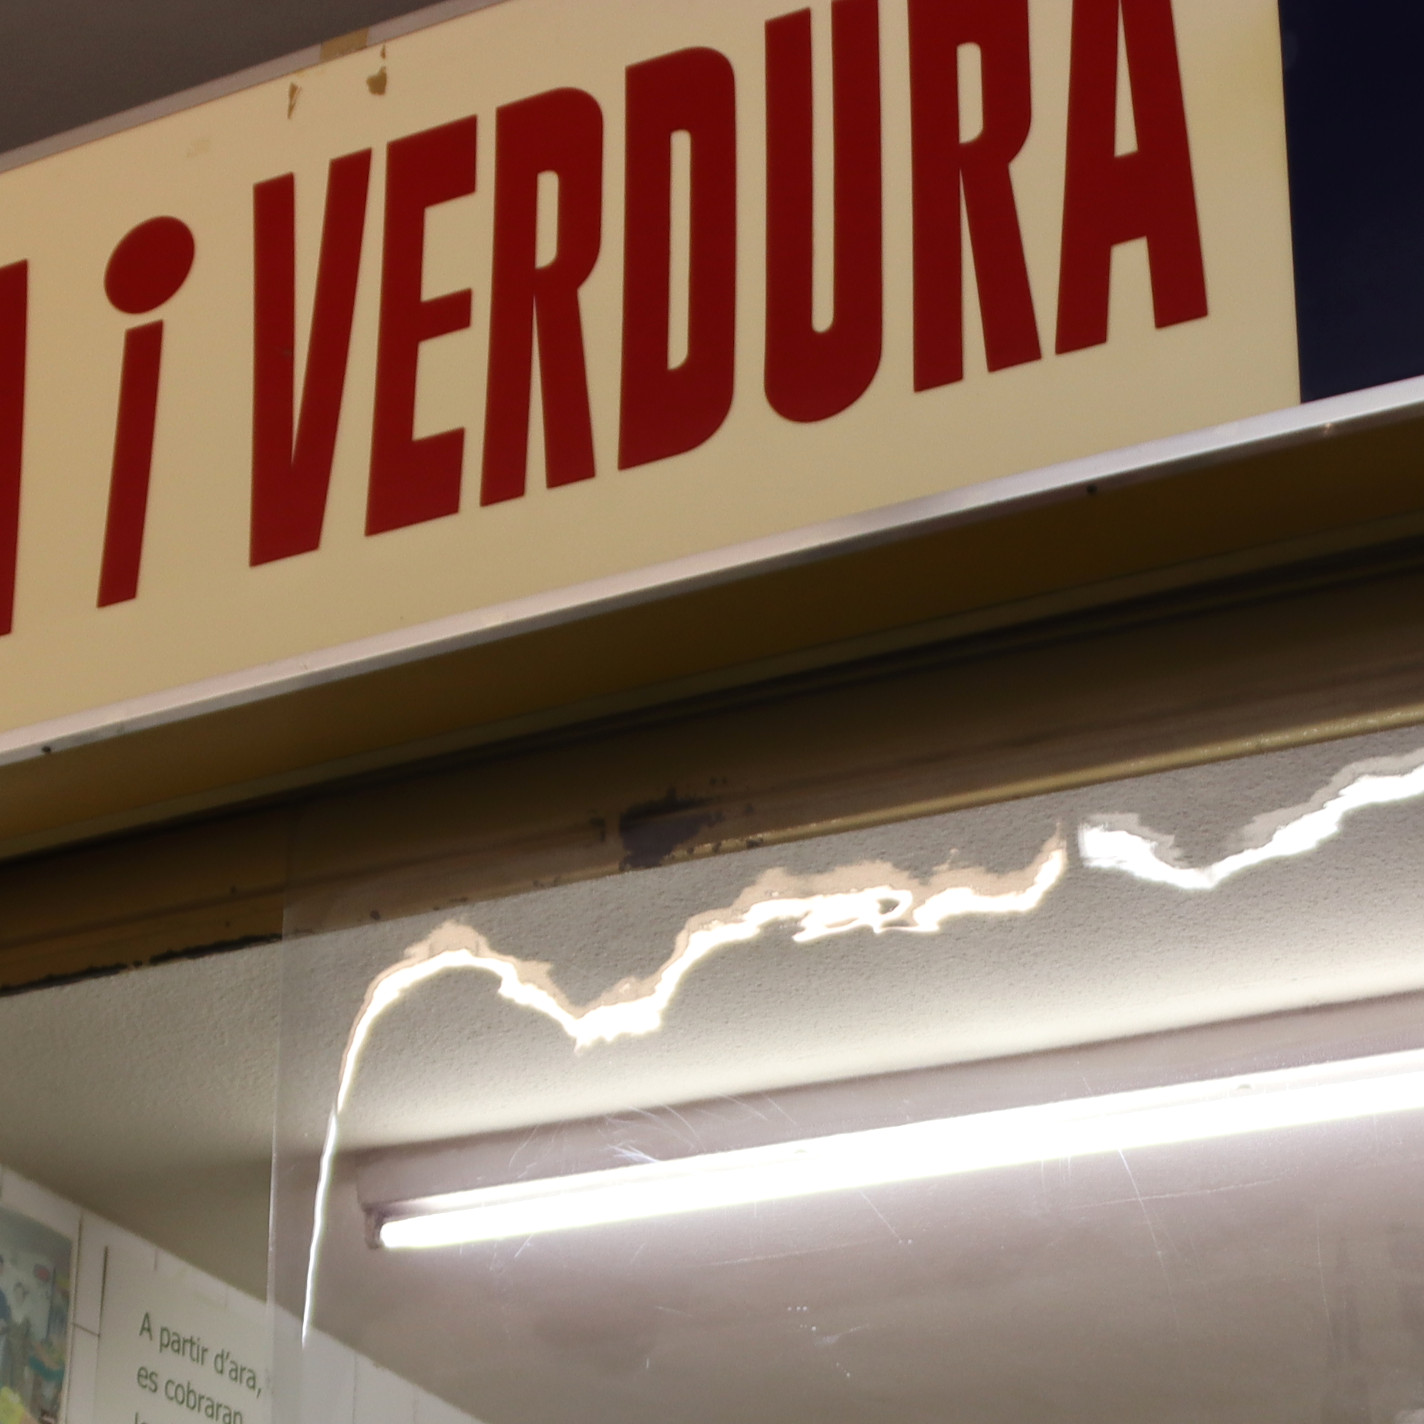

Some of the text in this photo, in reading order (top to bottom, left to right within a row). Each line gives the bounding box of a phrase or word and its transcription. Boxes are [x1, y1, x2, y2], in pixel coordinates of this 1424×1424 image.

[97, 215, 196, 608] i
[249, 0, 1209, 567] VERDURA
[139, 1312, 153, 1341] A
[159, 1327, 209, 1366] partir
[137, 1366, 159, 1393] es
